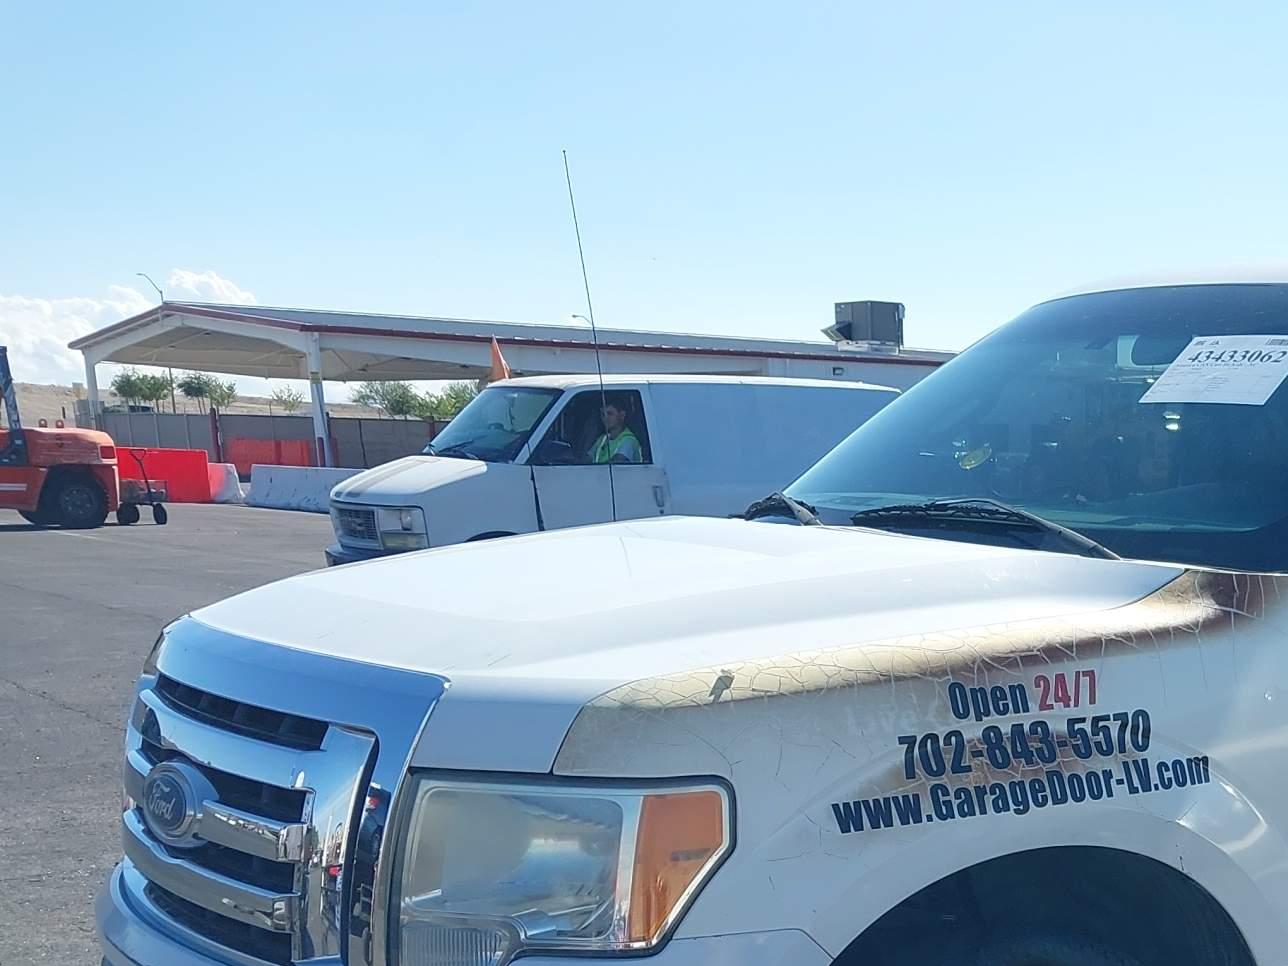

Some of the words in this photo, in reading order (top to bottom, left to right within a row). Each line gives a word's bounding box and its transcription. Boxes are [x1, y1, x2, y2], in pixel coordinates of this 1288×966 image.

[1188, 350, 1288, 363] 43433062
[949, 681, 1030, 721] Open
[1034, 669, 1098, 712] 24/7
[898, 709, 1152, 780] 702-843-5570
[149, 780, 176, 820] Ford
[832, 754, 1211, 834] www.GarageDoor-LV.com
